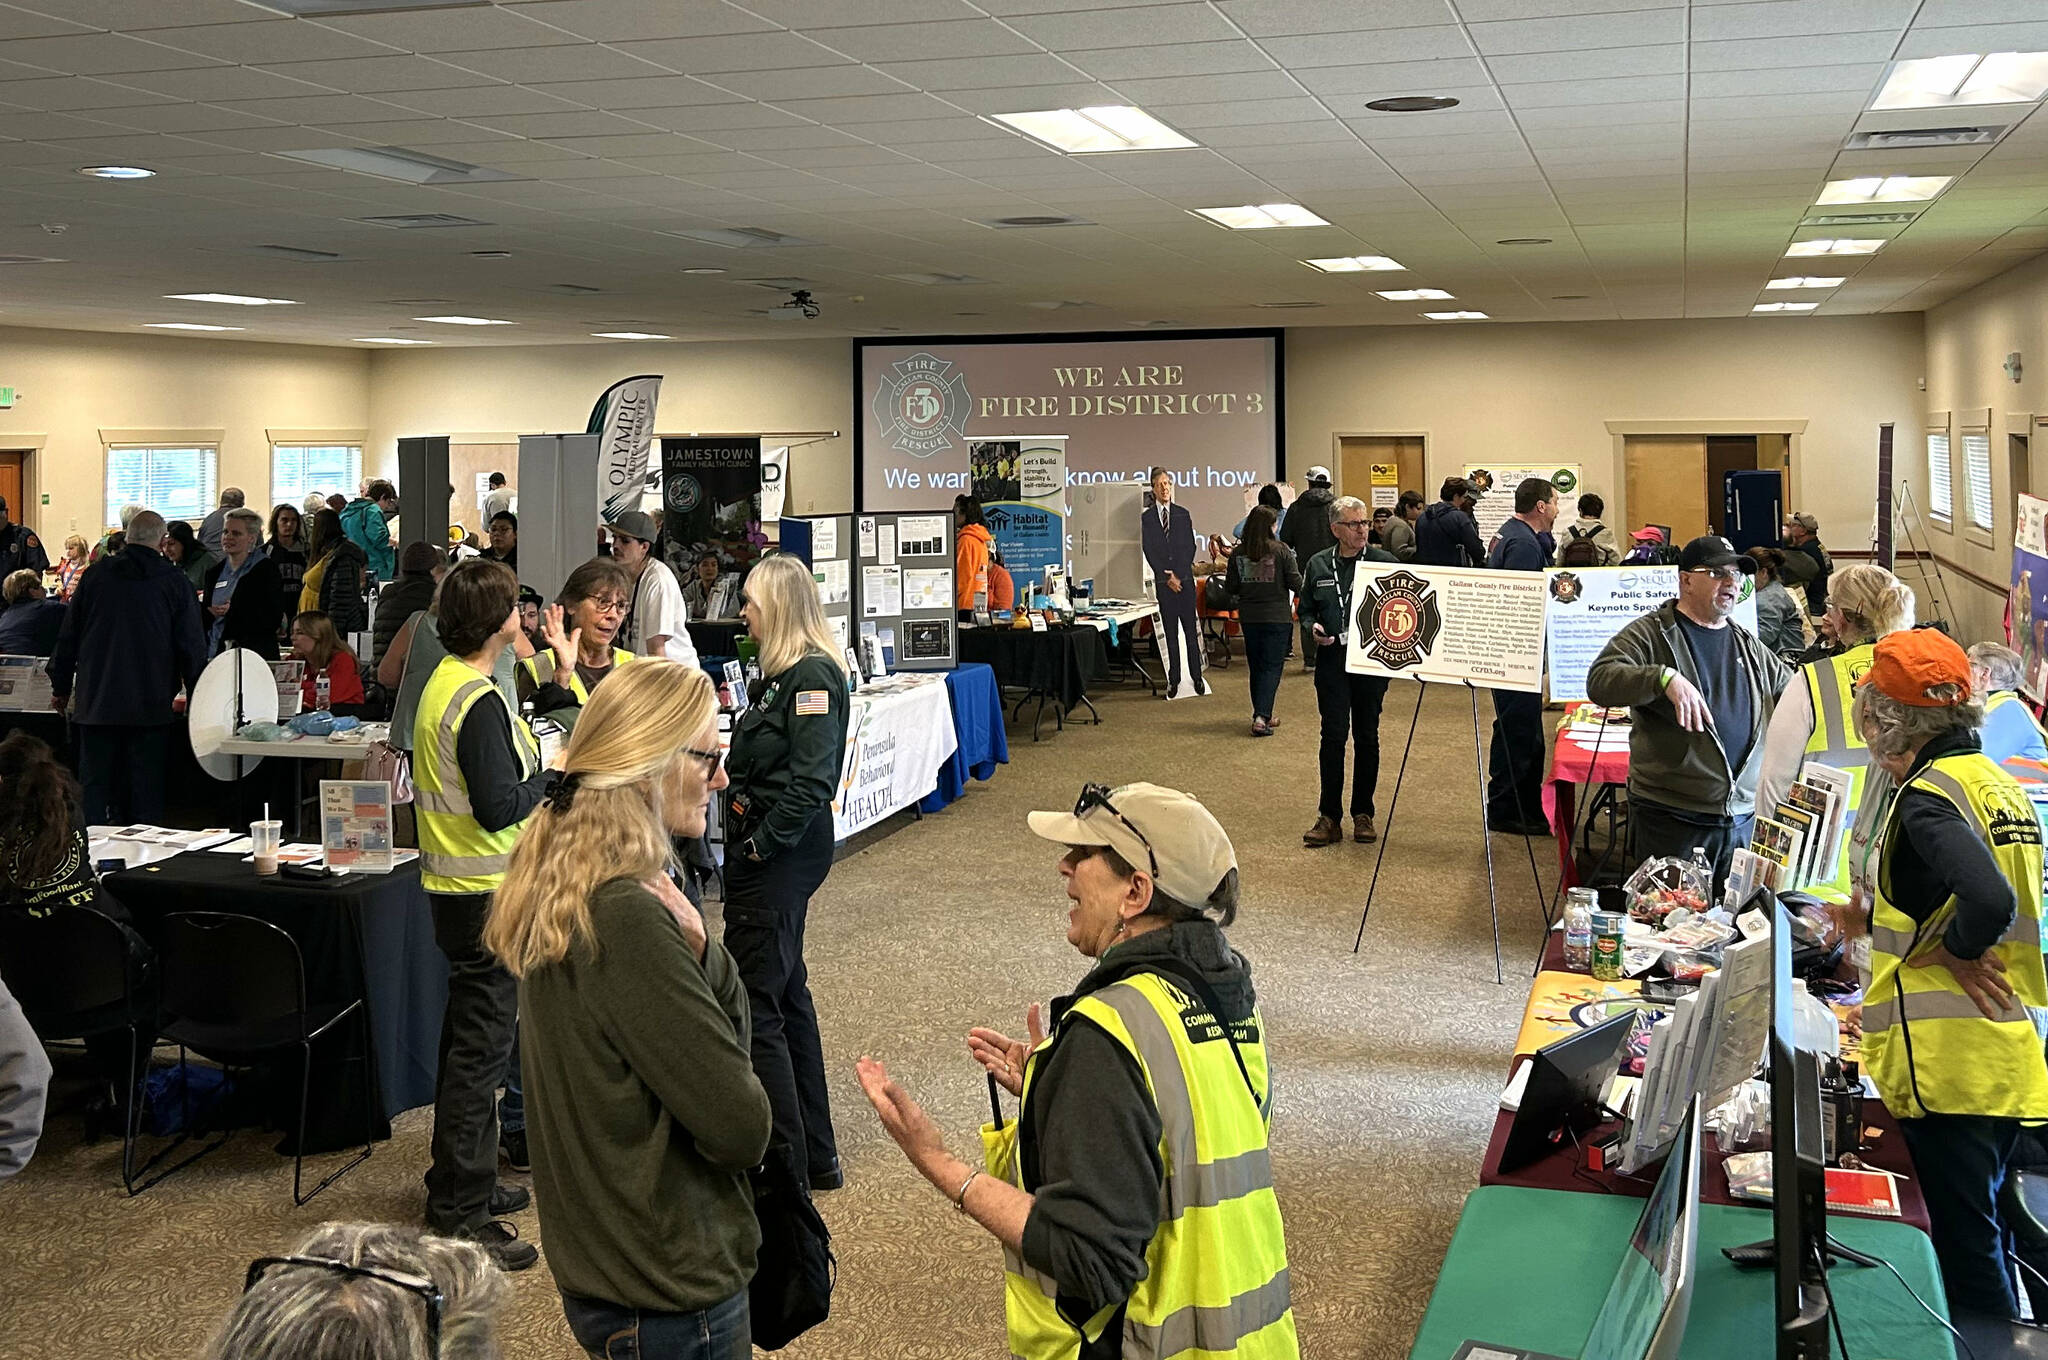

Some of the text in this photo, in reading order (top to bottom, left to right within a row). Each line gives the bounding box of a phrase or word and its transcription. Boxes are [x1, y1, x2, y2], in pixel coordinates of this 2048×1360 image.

[907, 360, 937, 371] FIRE
[1052, 365, 1183, 387] WE ARE
[979, 392, 1264, 417] FIRE DISTRICT 3
[911, 422, 945, 437] DISTRICT
[608, 388, 639, 486] OLYMPIC
[627, 398, 648, 480] MEDICAL CENTER
[901, 437, 945, 449] RESCUE
[667, 448, 753, 460] JAMESTOWN
[672, 460, 697, 468] FAMILY
[698, 460, 725, 468] HEALTH
[884, 468, 921, 488] We
[1065, 466, 1125, 487] know
[1206, 466, 1256, 487] how
[1012, 513, 1049, 524] Habitat
[1390, 578, 1415, 589] FIRE
[1474, 582, 1497, 590] County
[1376, 590, 1402, 610] CLALLAM
[1403, 590, 1422, 612] COUNTY
[1645, 590, 1678, 598] Safety
[1588, 604, 1630, 613] Keynote
[1388, 637, 1415, 649] DISTRICT
[1378, 647, 1414, 661] RESCUE
[862, 731, 896, 762] Peninsula
[848, 783, 893, 827] HEALTH
[1184, 1013, 1217, 1027] COMM
